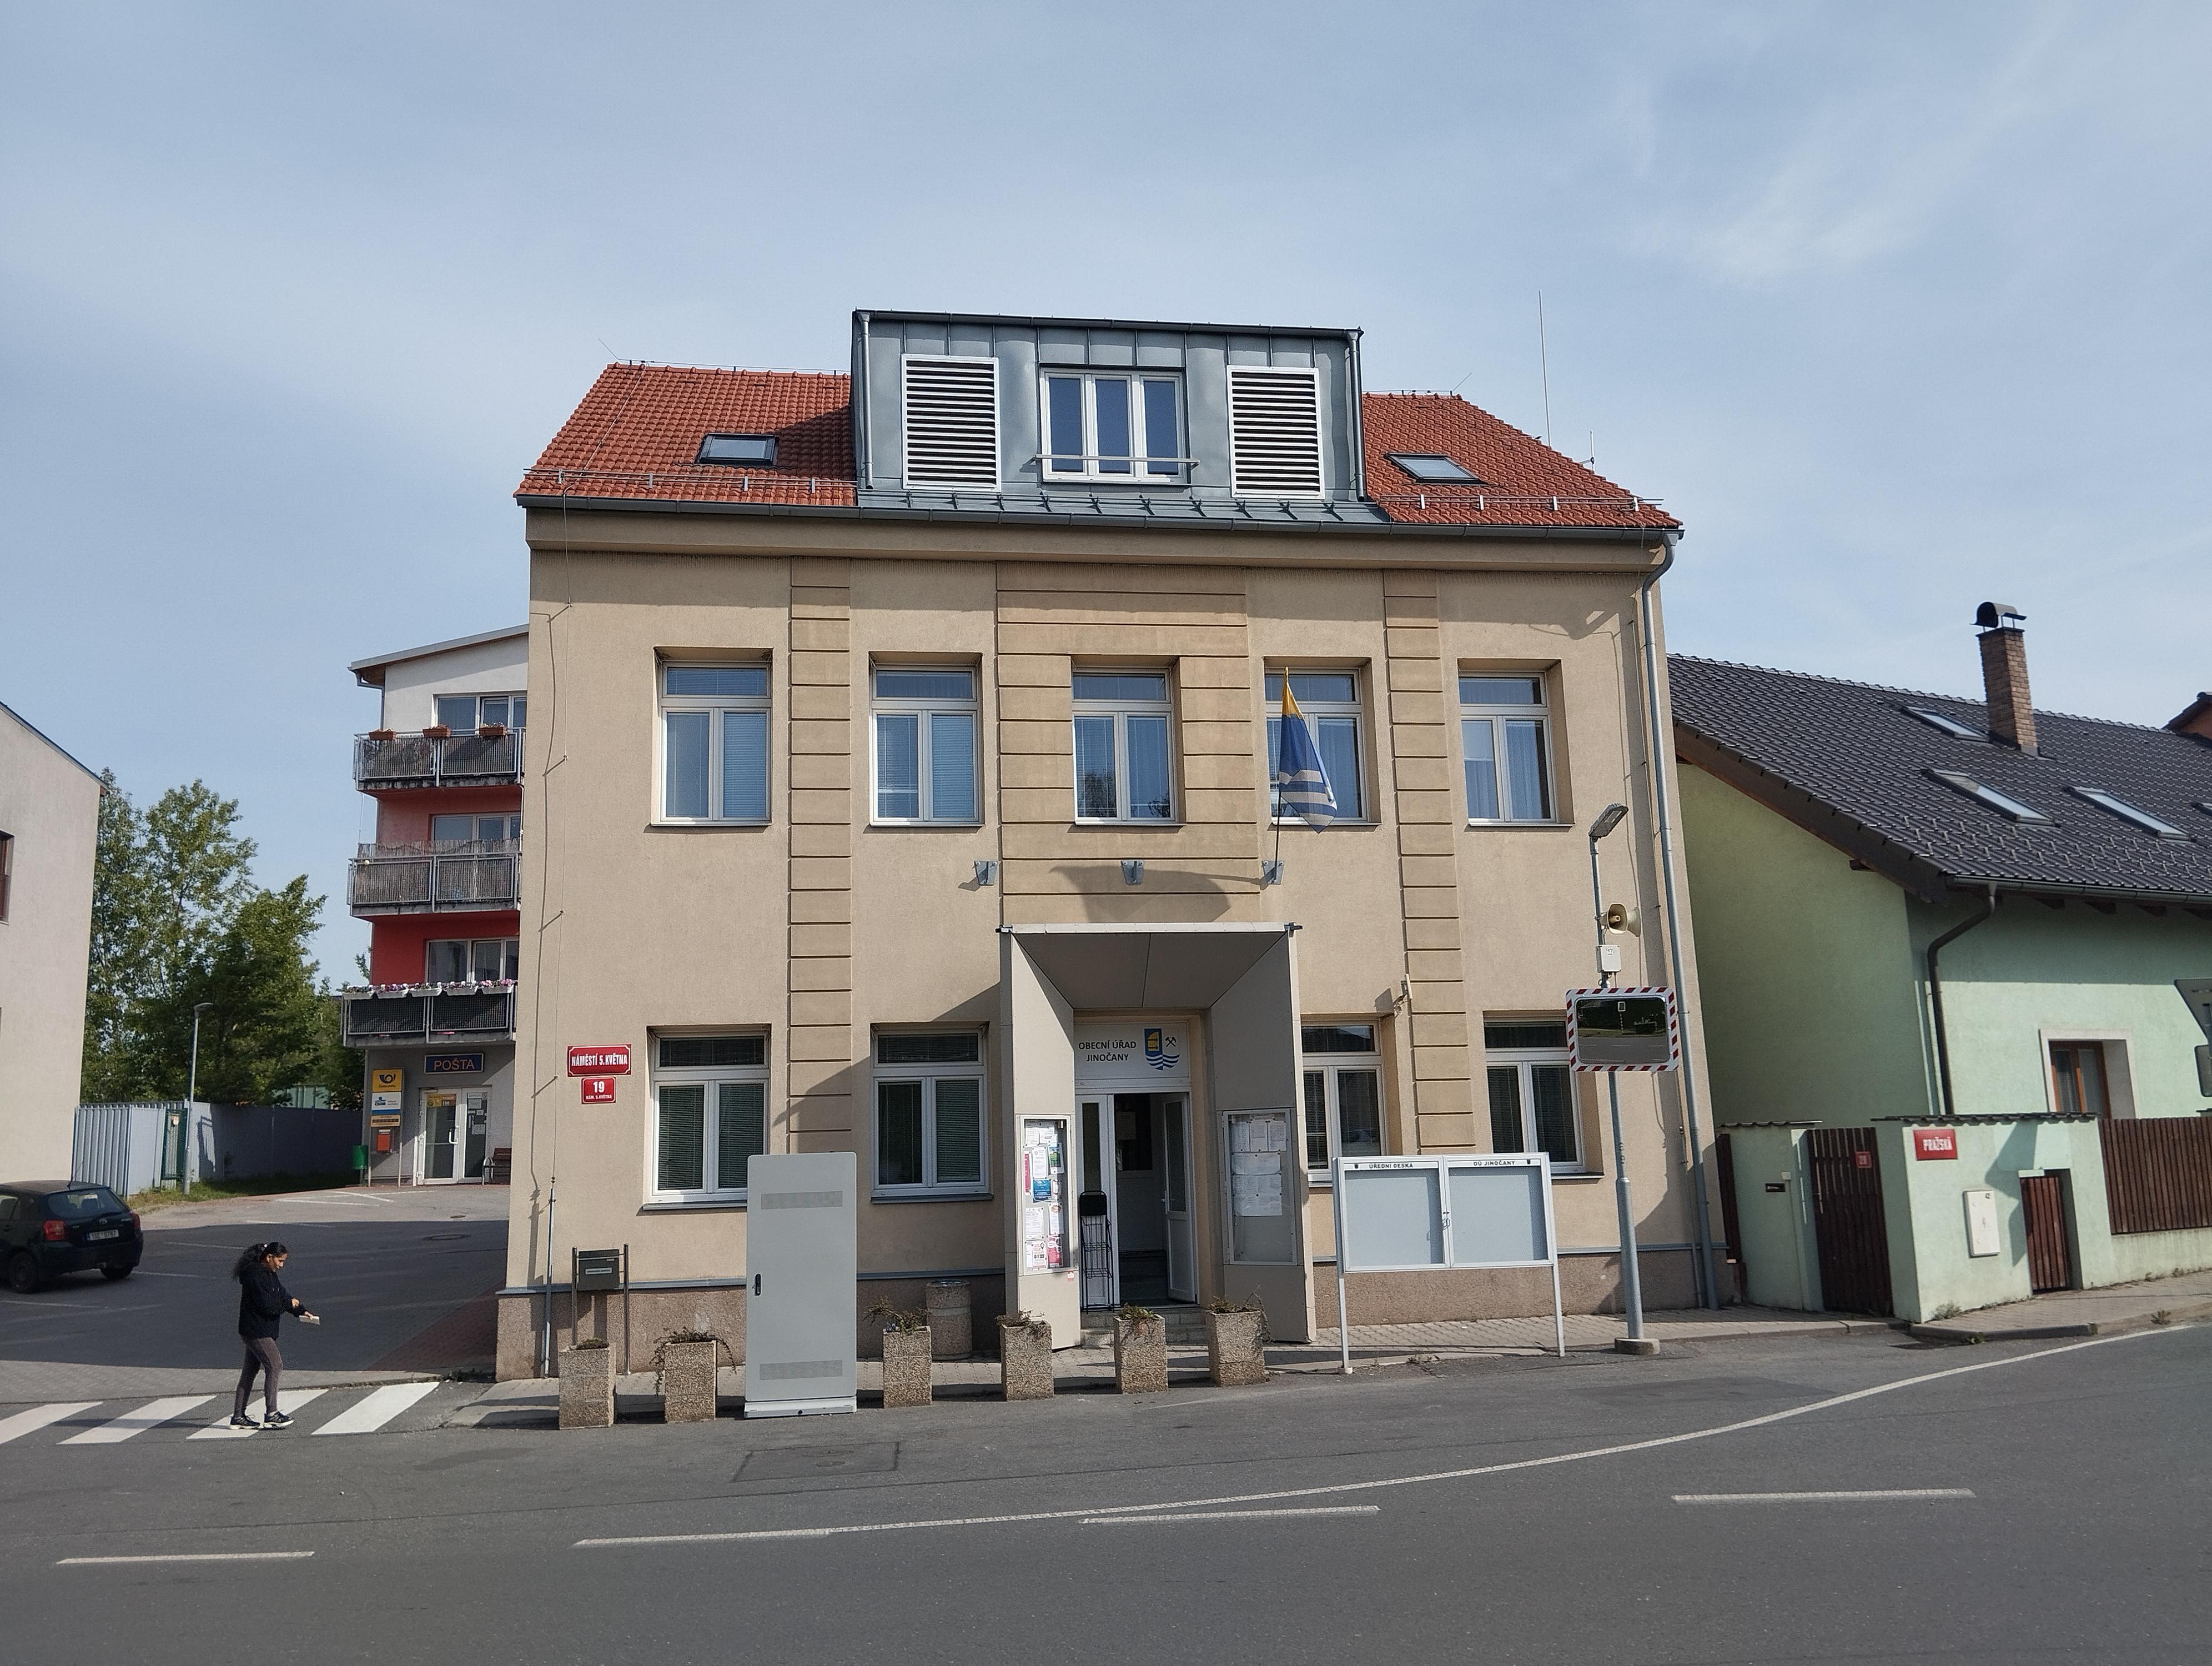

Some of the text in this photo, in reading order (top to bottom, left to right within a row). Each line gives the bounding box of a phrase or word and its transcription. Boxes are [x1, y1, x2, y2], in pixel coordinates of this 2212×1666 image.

[1078, 1039, 1137, 1050] OBECNÍ ÚŘAD
[571, 1053, 598, 1066] NÁMĚSTÍ
[1087, 1052, 1129, 1062] JINOČANY
[434, 1057, 475, 1071] POŠTA
[593, 1081, 605, 1093] 19
